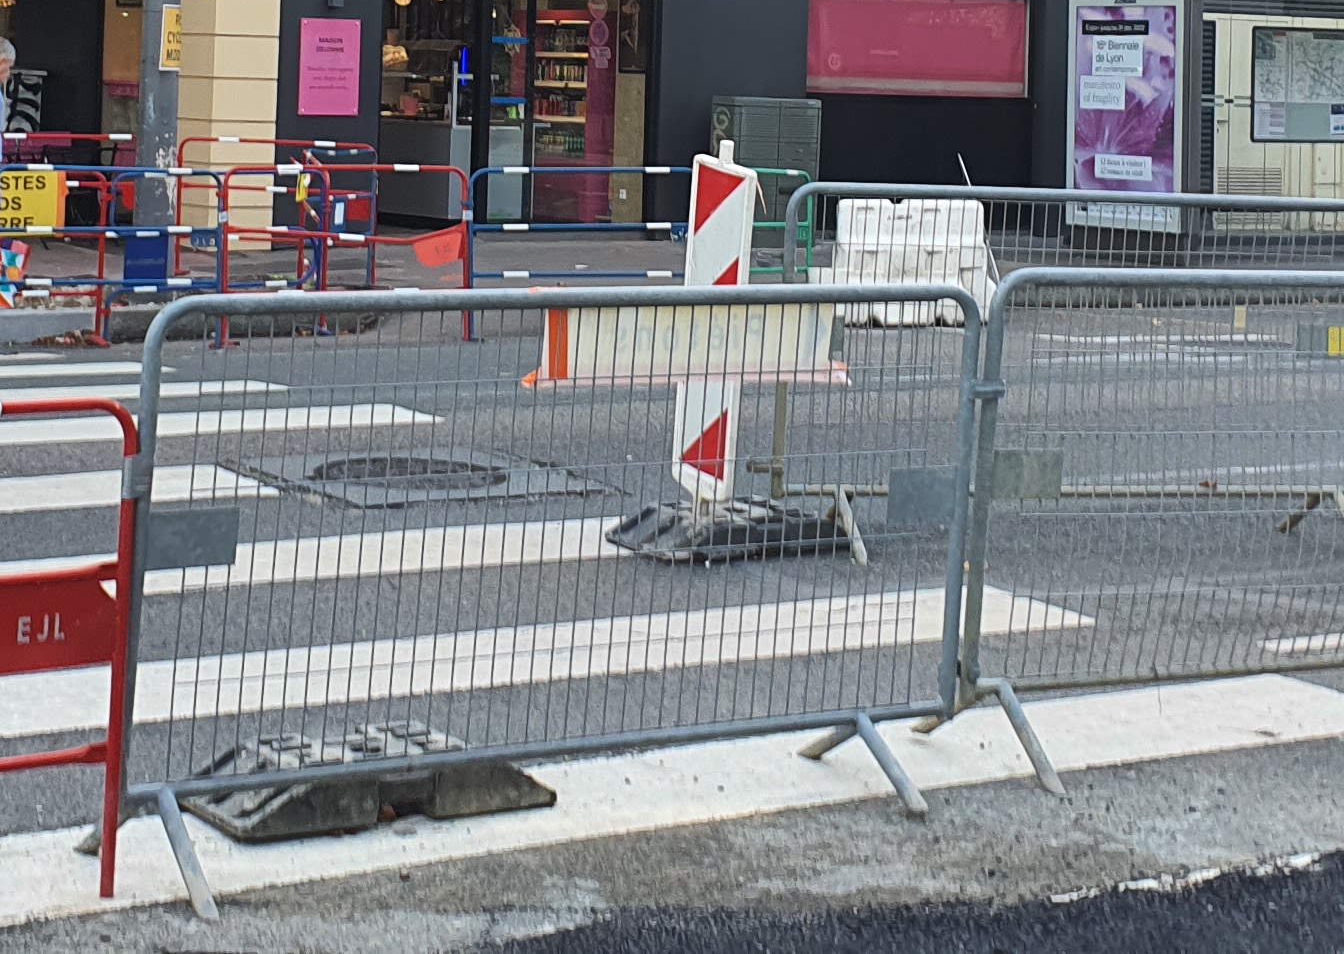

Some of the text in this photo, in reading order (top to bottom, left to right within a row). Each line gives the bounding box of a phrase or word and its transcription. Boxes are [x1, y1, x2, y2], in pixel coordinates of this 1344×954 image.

[1108, 39, 1139, 51] Biennale
[1096, 53, 1124, 65] de Lyon
[16, 612, 66, 645] EJL
